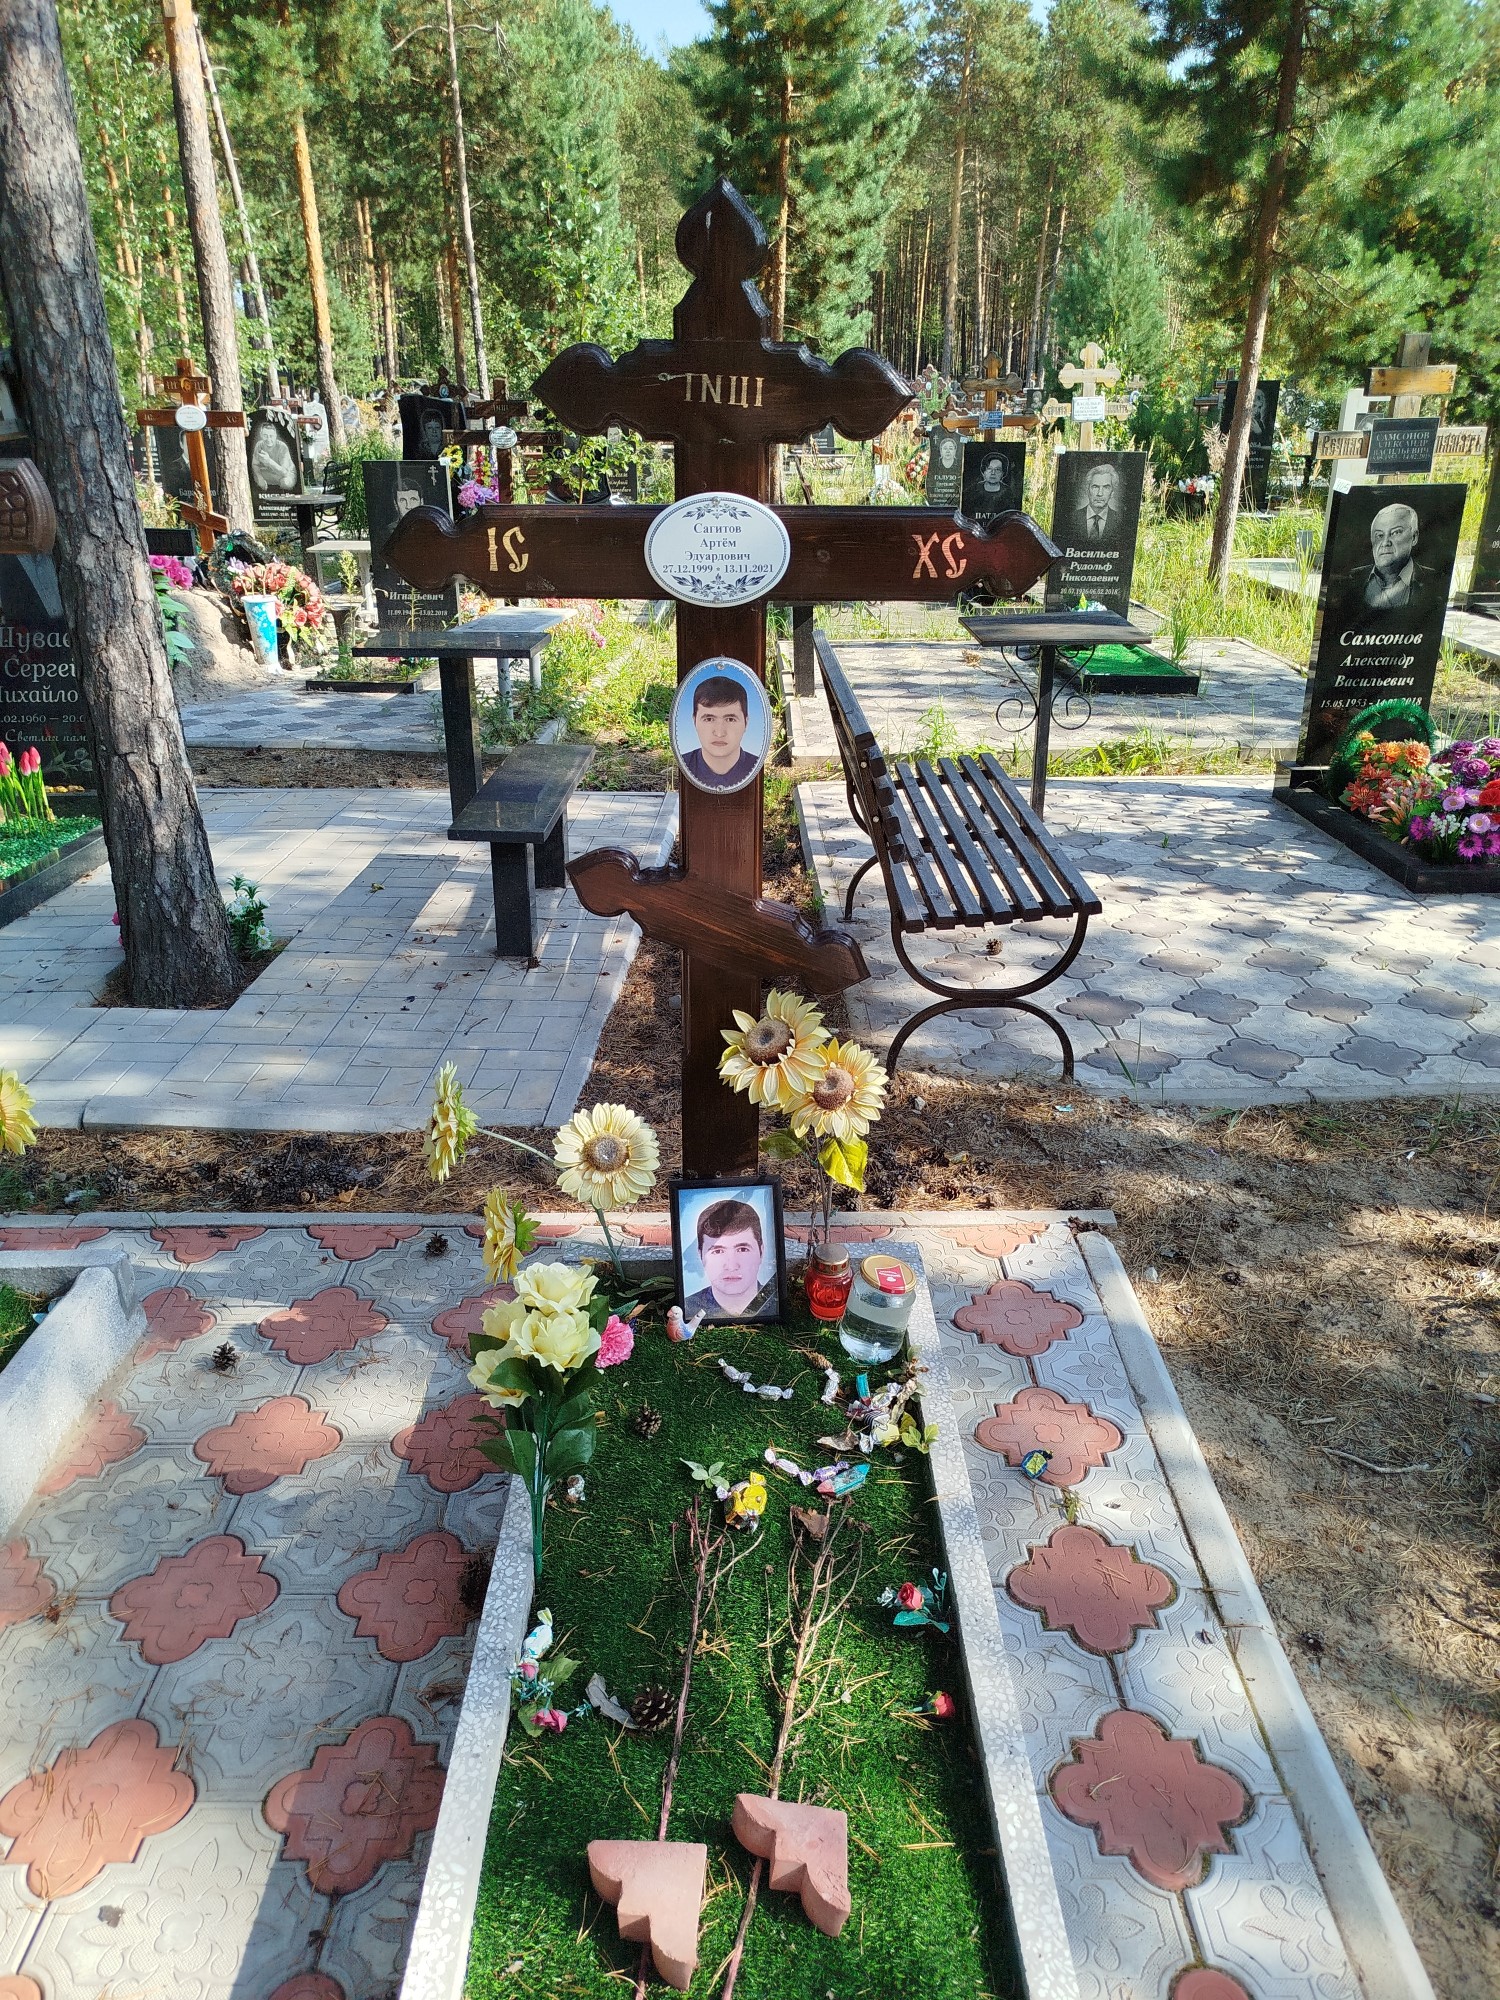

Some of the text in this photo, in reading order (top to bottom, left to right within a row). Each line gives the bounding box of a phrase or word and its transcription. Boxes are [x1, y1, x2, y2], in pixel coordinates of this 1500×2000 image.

[693, 522, 742, 534] Сагитов
[699, 537, 737, 549] Артём
[685, 550, 751, 563] Эдуардович
[1065, 547, 1120, 559] Васильев
[662, 564, 774, 573] 27.12.1999 13.11.2021
[1070, 561, 1113, 572] Рудольф
[1061, 572, 1120, 583] Николаевич
[1339, 630, 1424, 646] Самсонов
[1339, 653, 1415, 669] Александр
[1334, 674, 1415, 687] Васильевич
[1320, 698, 1367, 708] 15.05.1953
